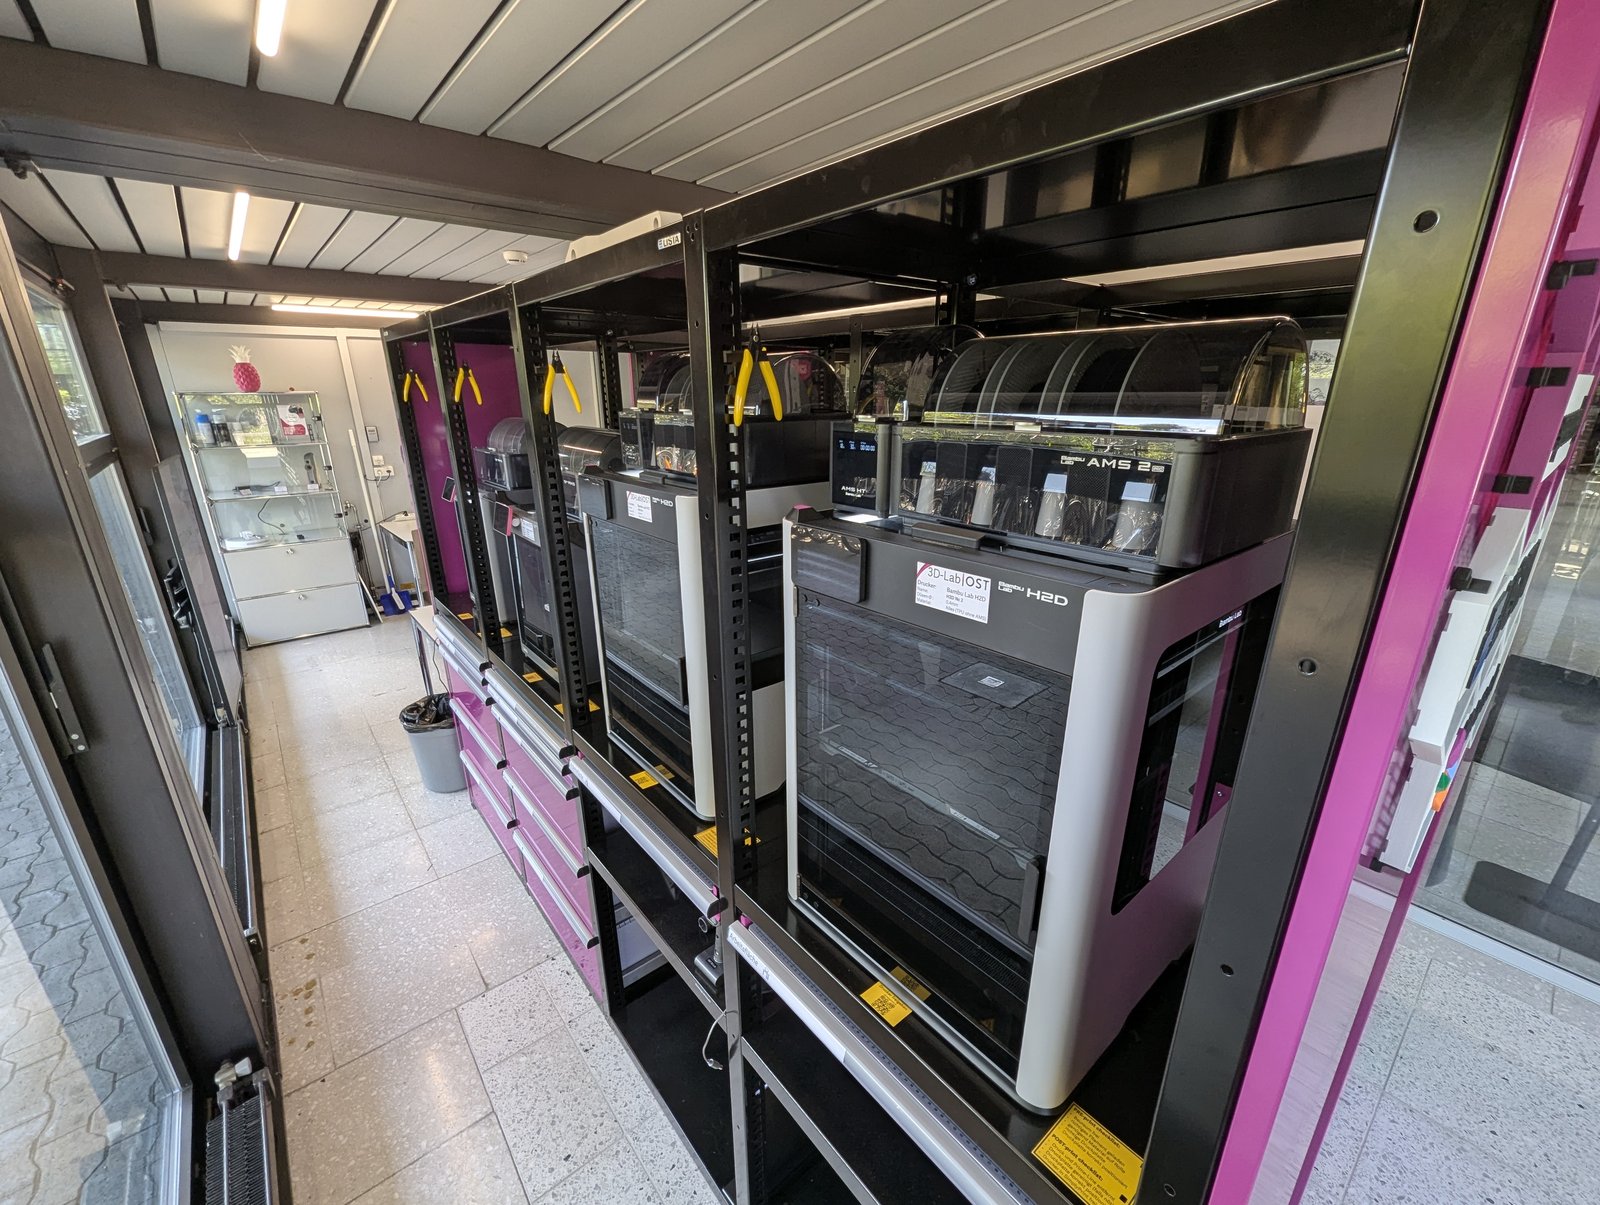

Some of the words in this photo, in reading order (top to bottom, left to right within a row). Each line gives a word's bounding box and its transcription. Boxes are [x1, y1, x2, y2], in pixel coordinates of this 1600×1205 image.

[1086, 458, 1132, 470] AMS
[1138, 462, 1152, 472] 2
[946, 587, 964, 597] Bambu
[974, 594, 986, 602] H2D
[998, 581, 1025, 592] Bambu
[1026, 588, 1068, 606] H2D
[1048, 1145, 1074, 1171] Druckplatte
[1050, 1132, 1078, 1160] POST-print
[1077, 1156, 1104, 1182] checklist:
[1051, 1142, 1065, 1156] Druck
[1063, 1153, 1074, 1164] und
[1061, 1129, 1087, 1153] Druckplatte
[1085, 1150, 1102, 1166] korrekt
[1079, 1138, 1106, 1164] Druckplatte
[1087, 1139, 1106, 1157] Material
[1044, 1149, 1071, 1175] Druckplatte
[1069, 1172, 1086, 1189] korrekt
